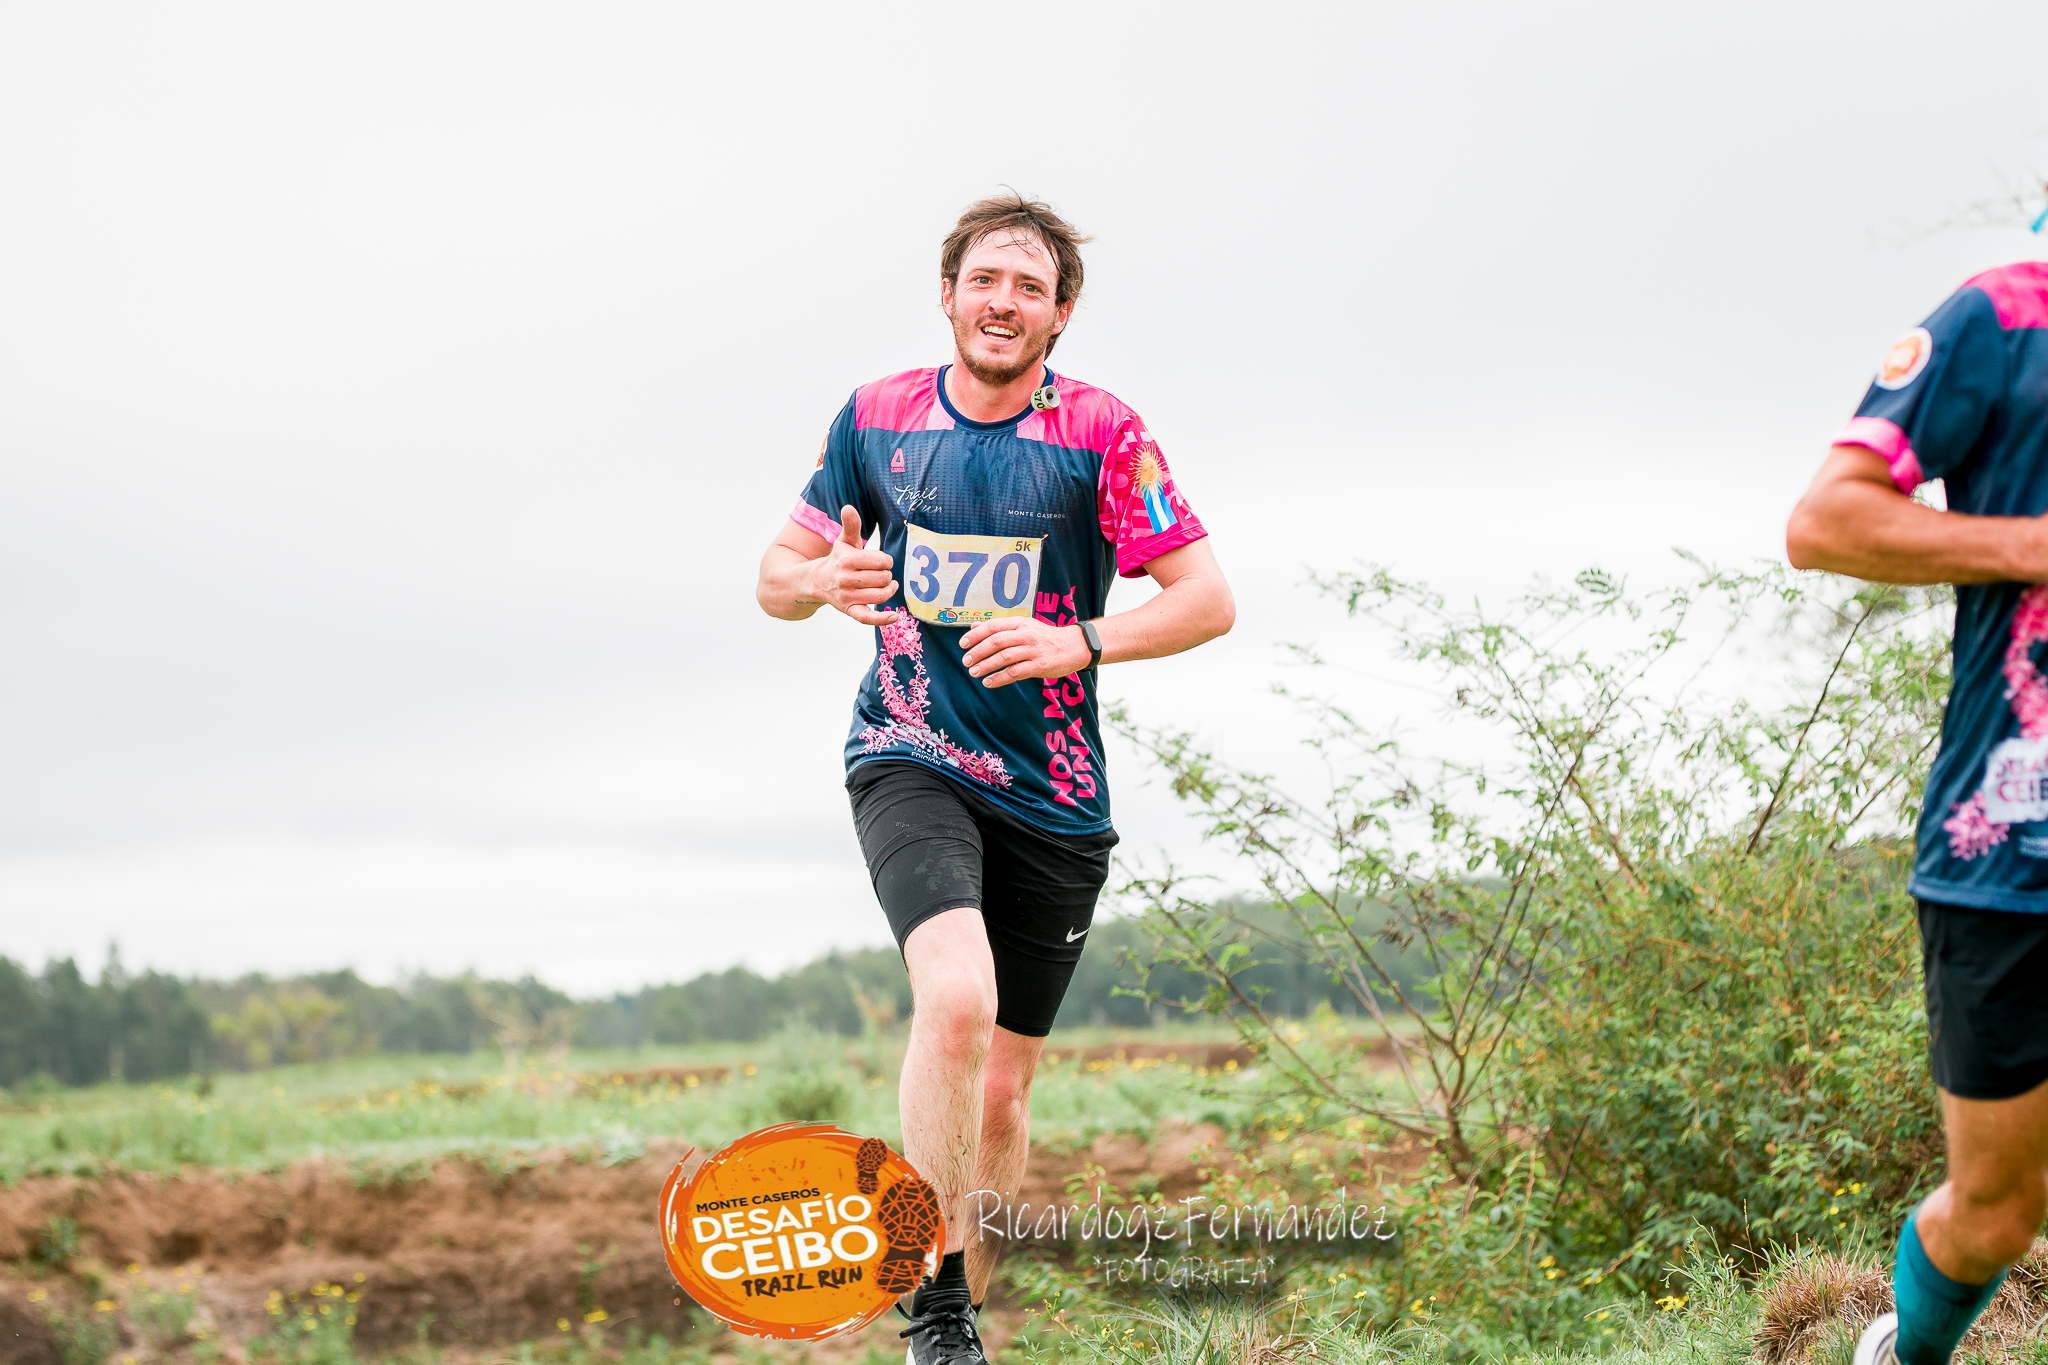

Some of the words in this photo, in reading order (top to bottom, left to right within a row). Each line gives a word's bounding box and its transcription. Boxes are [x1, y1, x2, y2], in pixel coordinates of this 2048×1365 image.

[894, 484, 938, 506] Trail
[907, 498, 945, 515] Run
[1007, 509, 1035, 518] MONTE
[912, 529, 994, 547] crc-system.com
[909, 544, 1031, 609] 370
[1057, 585, 1085, 707] CSA
[1046, 729, 1078, 807] NOS
[1066, 716, 1097, 799] UNA
